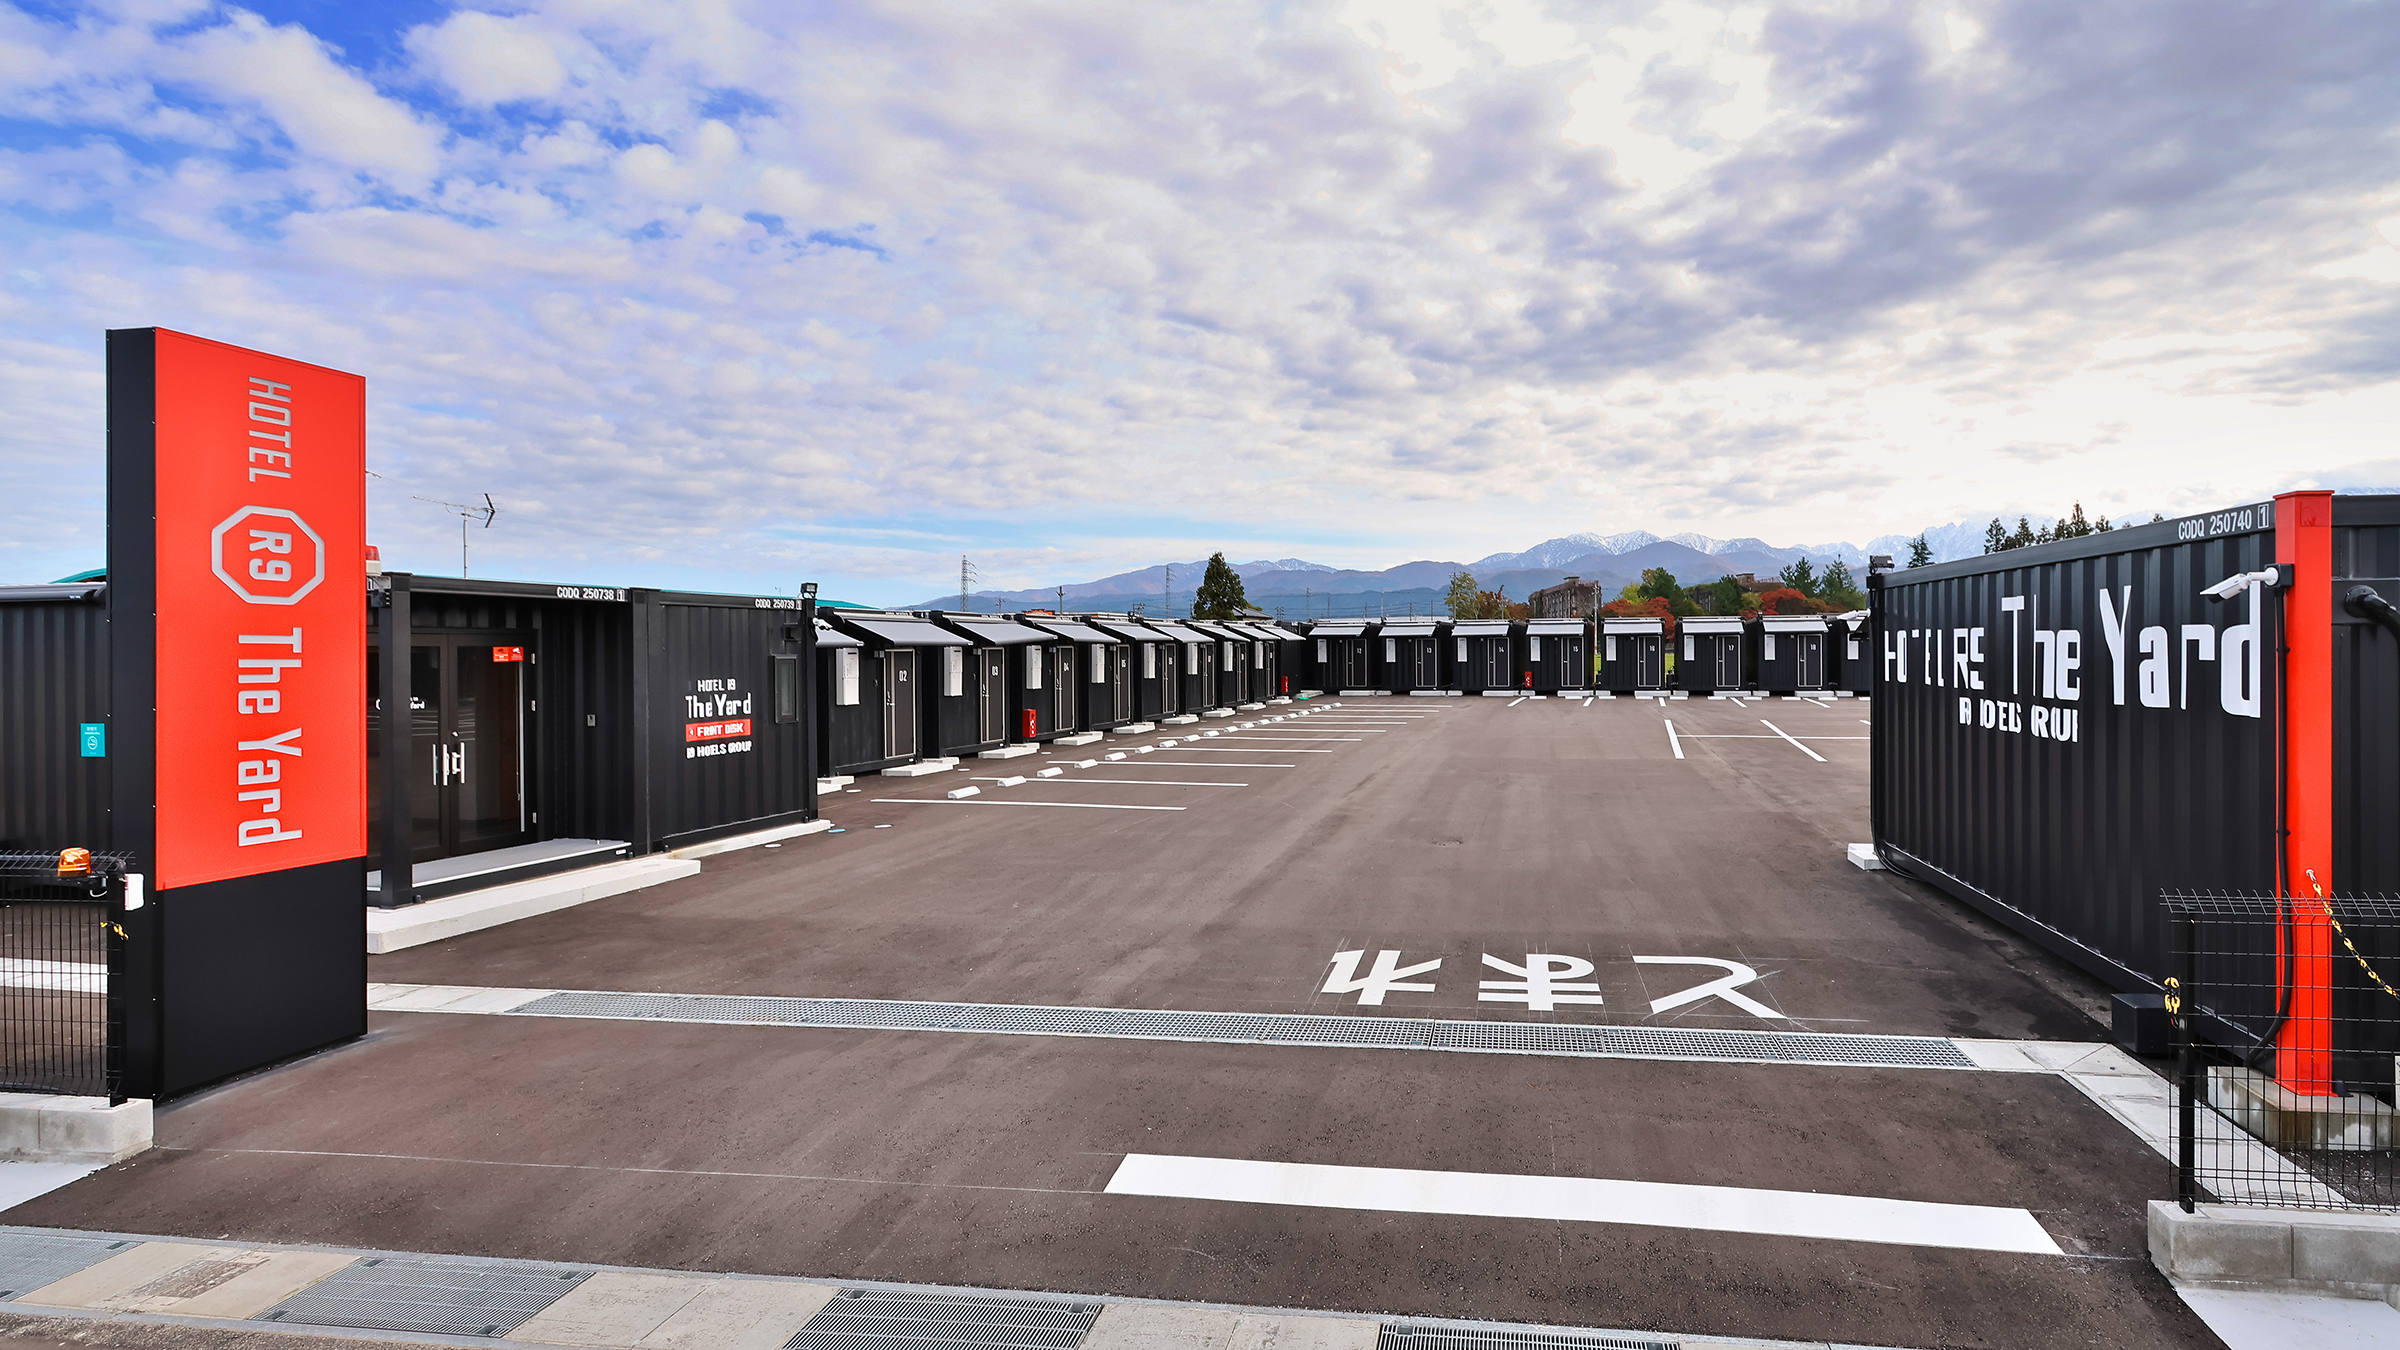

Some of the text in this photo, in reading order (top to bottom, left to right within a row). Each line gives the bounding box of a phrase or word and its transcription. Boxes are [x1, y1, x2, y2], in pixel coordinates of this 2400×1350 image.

[2178, 518, 2205, 541] CODQ
[2209, 508, 2252, 535] 250740
[556, 586, 580, 599] CODQ
[582, 587, 615, 601] 250738
[237, 375, 303, 847] HOTEL R9 The Yard
[773, 599, 795, 610] 250739
[2001, 593, 2081, 702] The
[2099, 580, 2261, 719] Yard
[898, 670, 908, 683] 02
[991, 665, 999, 677] 03
[685, 692, 752, 719] The Yard
[697, 724, 723, 737] FRNT
